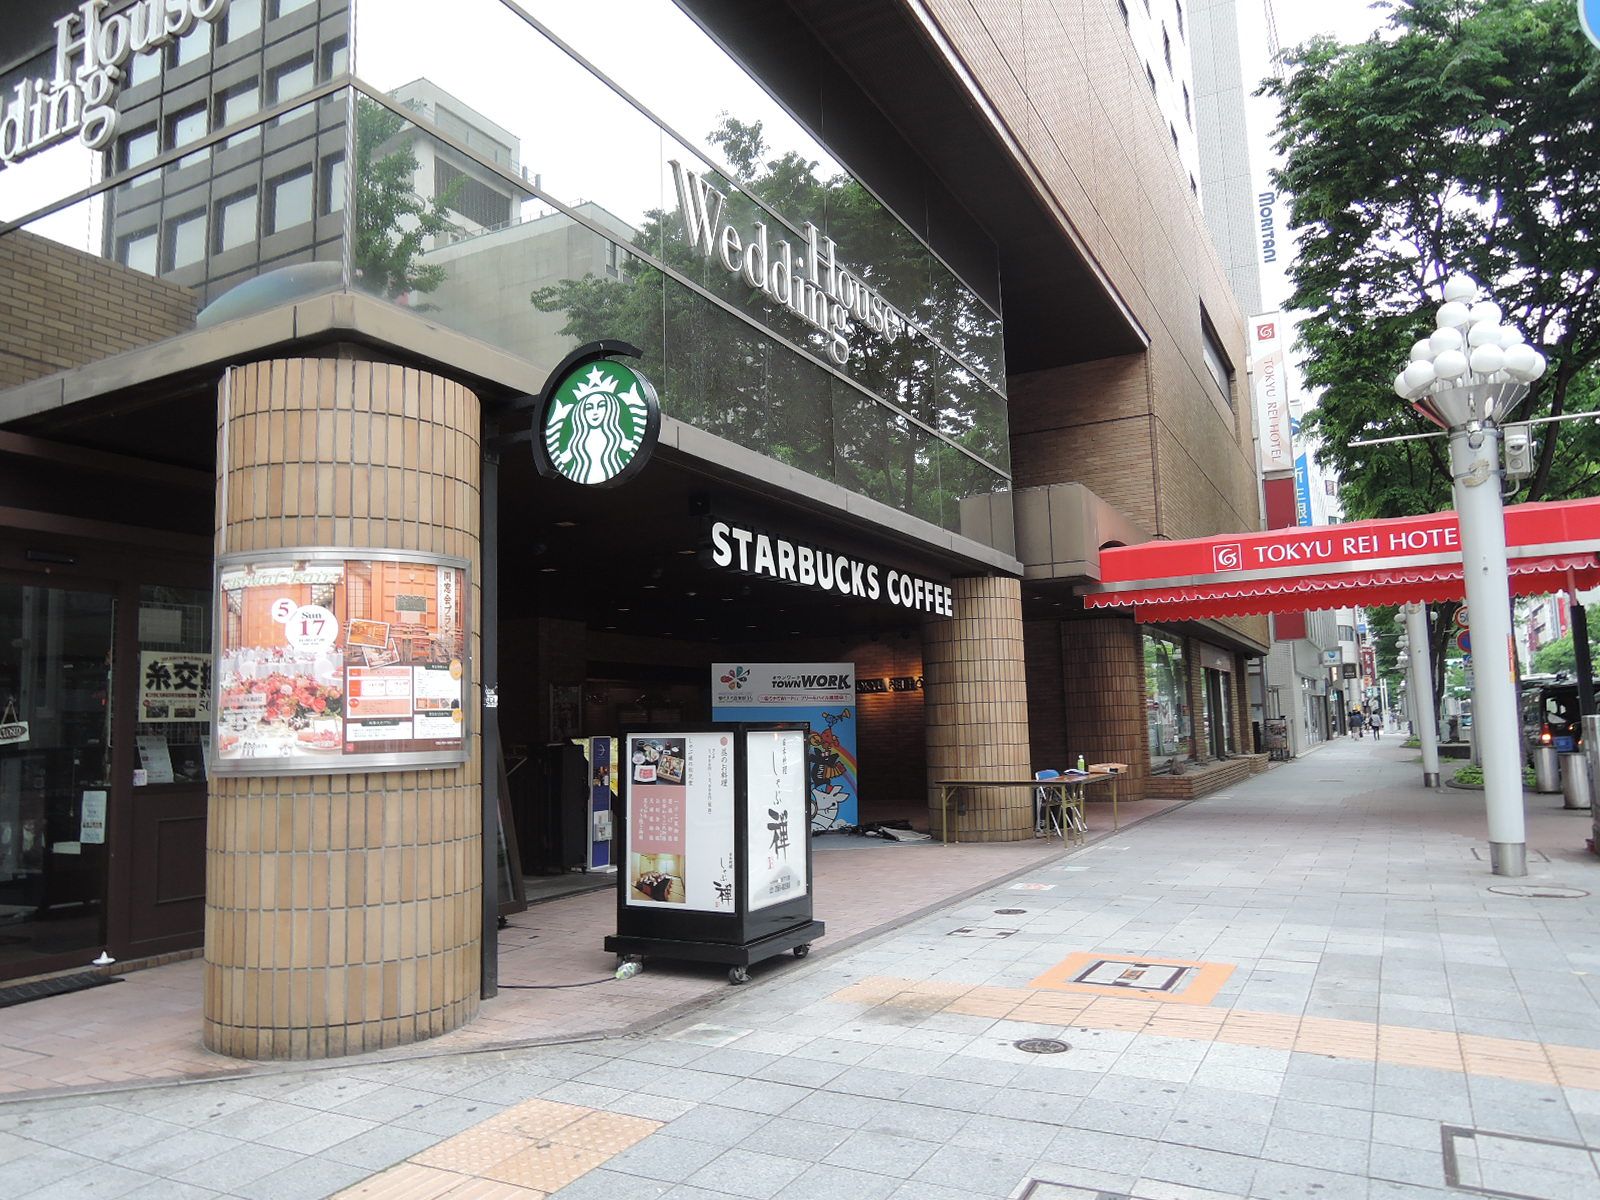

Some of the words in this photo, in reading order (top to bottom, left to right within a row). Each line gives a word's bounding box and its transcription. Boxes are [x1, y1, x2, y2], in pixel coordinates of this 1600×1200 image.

[0, 66, 122, 162] ding
[668, 160, 849, 364] Wedding
[801, 221, 897, 344] House
[1263, 357, 1275, 397] TOKYU
[1267, 401, 1278, 421] REI
[1270, 423, 1282, 463] HOTEL
[1253, 539, 1332, 563] TOKYU
[1343, 535, 1378, 555] REI
[1390, 527, 1459, 551] HOTE
[712, 522, 880, 600] STARBUCKS
[886, 570, 953, 617] COFFEE
[277, 602, 289, 617] 5
[300, 620, 325, 636] 17
